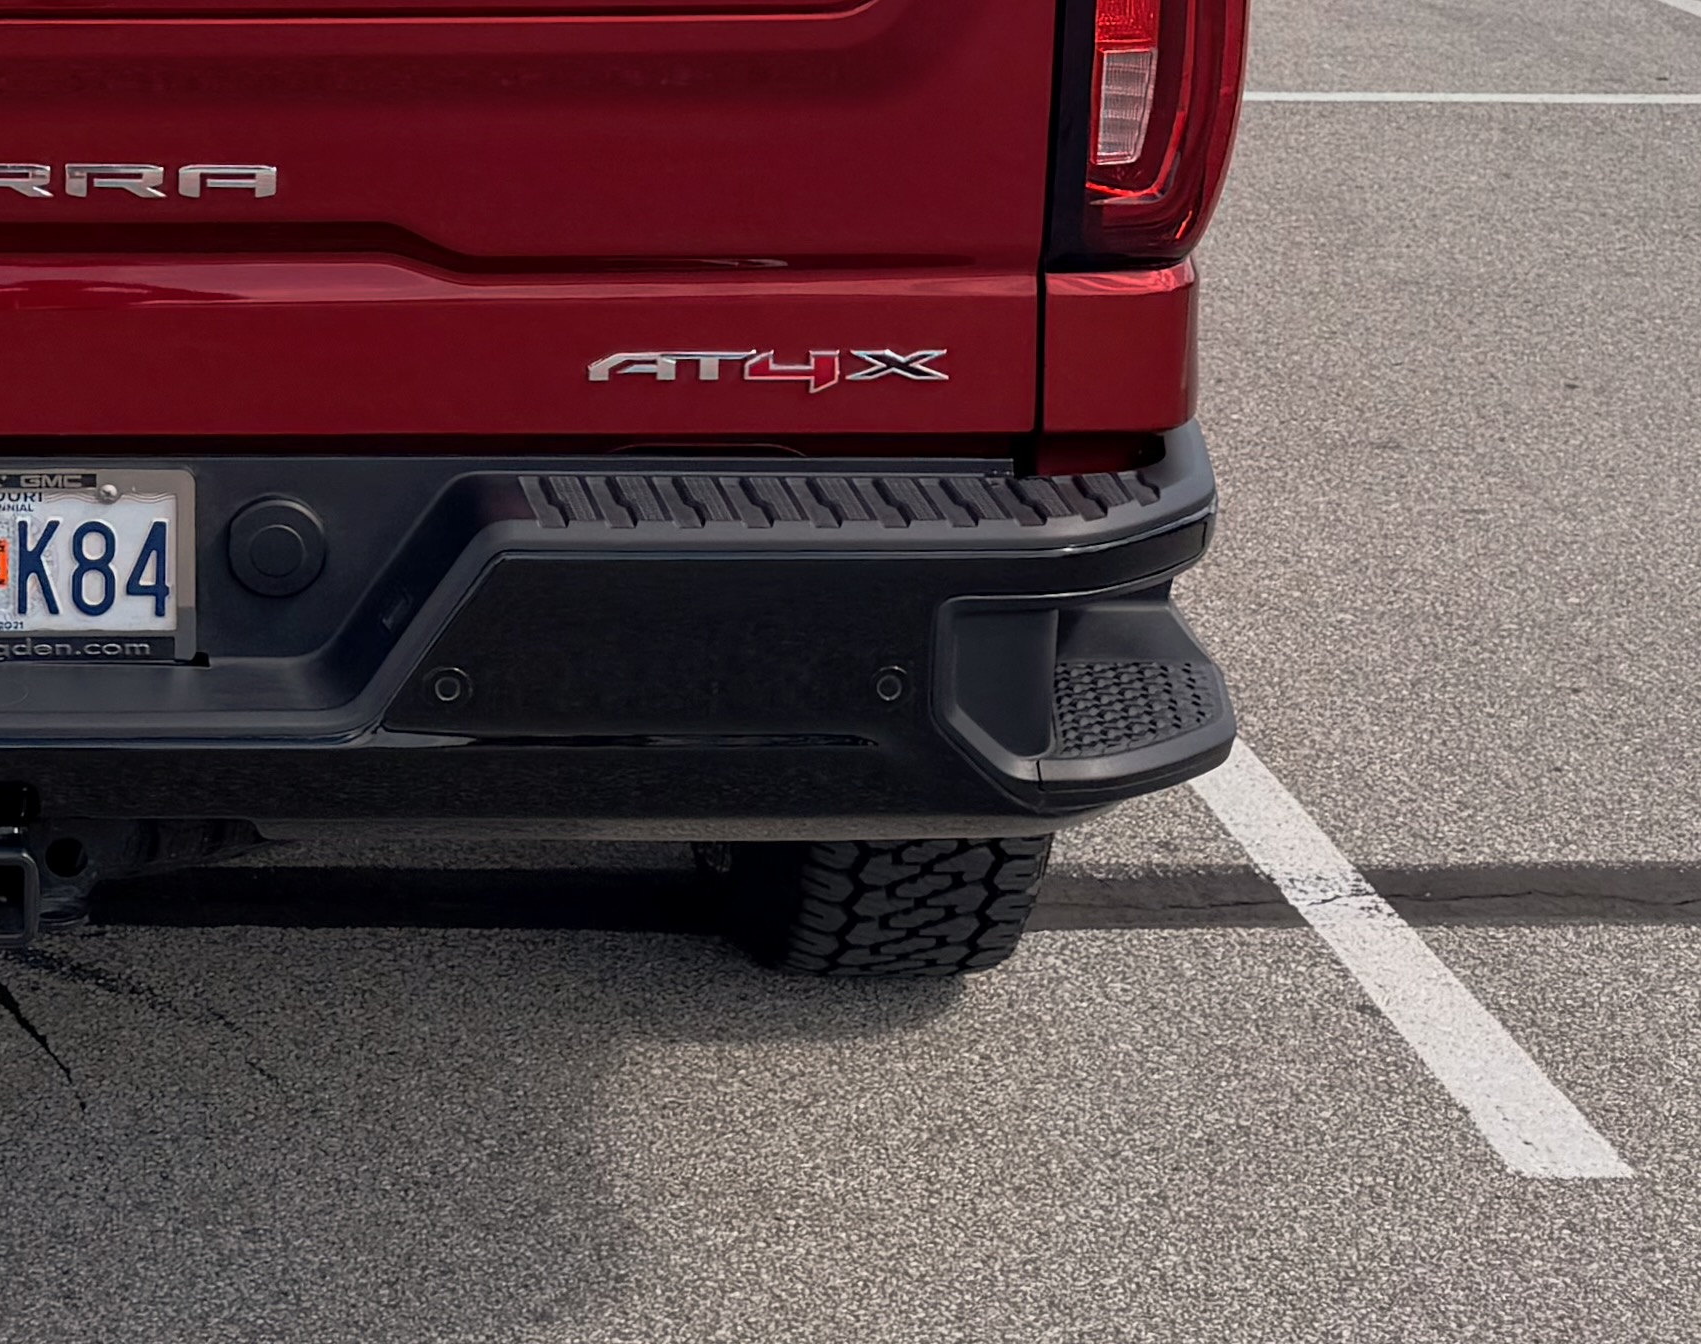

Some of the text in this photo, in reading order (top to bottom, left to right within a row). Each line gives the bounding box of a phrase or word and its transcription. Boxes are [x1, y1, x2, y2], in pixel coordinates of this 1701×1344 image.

[587, 348, 950, 394] AT4X
[20, 474, 83, 488] GMC
[17, 519, 171, 617] K84
